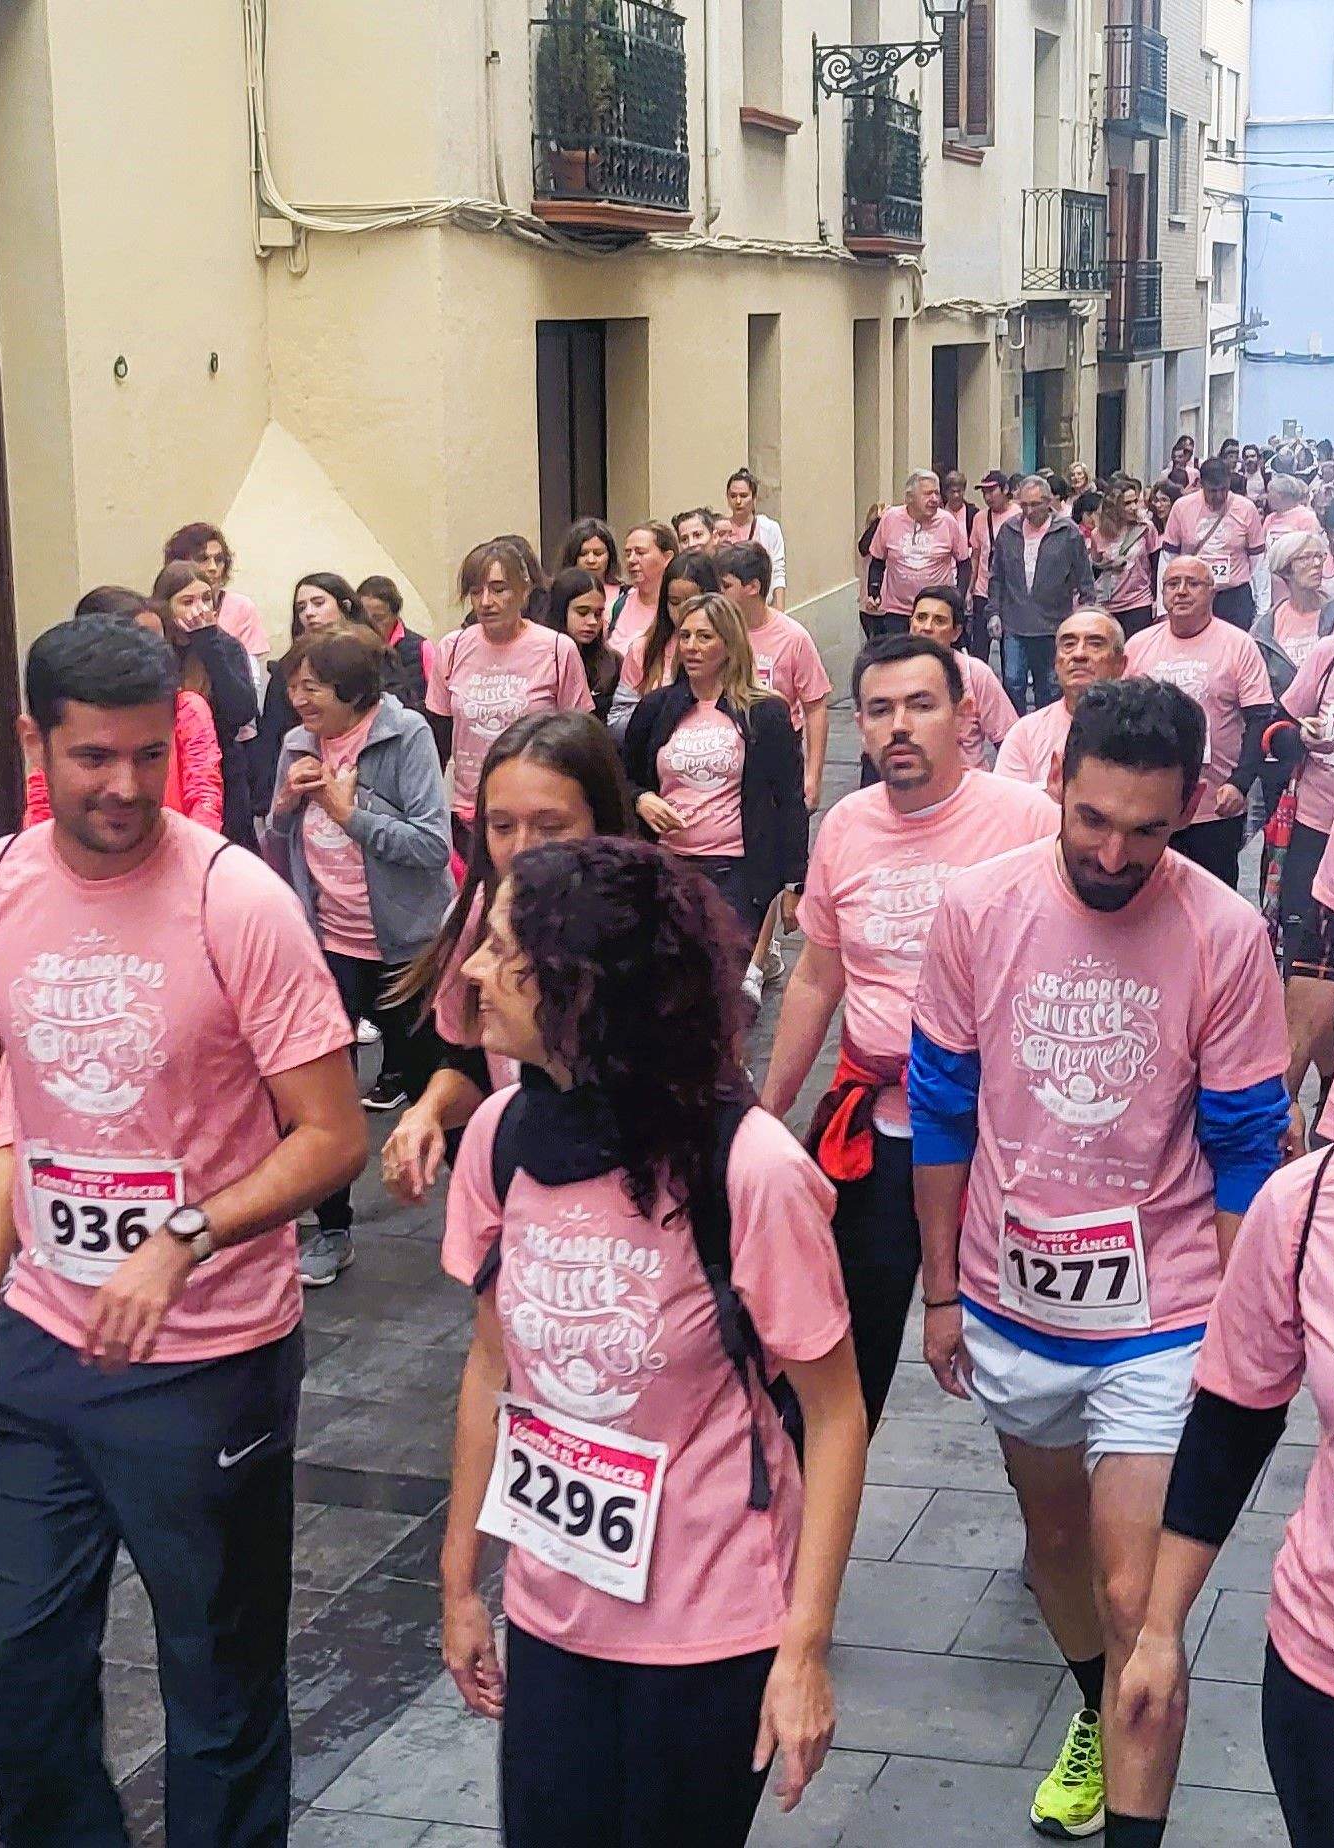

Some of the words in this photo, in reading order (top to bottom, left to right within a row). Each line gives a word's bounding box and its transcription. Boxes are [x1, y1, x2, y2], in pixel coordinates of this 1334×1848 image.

[50, 1199, 150, 1253] 936
[1070, 1235, 1127, 1253] CÁNCER
[1008, 1249, 1130, 1302] 1277
[509, 1448, 637, 1553] 2296
